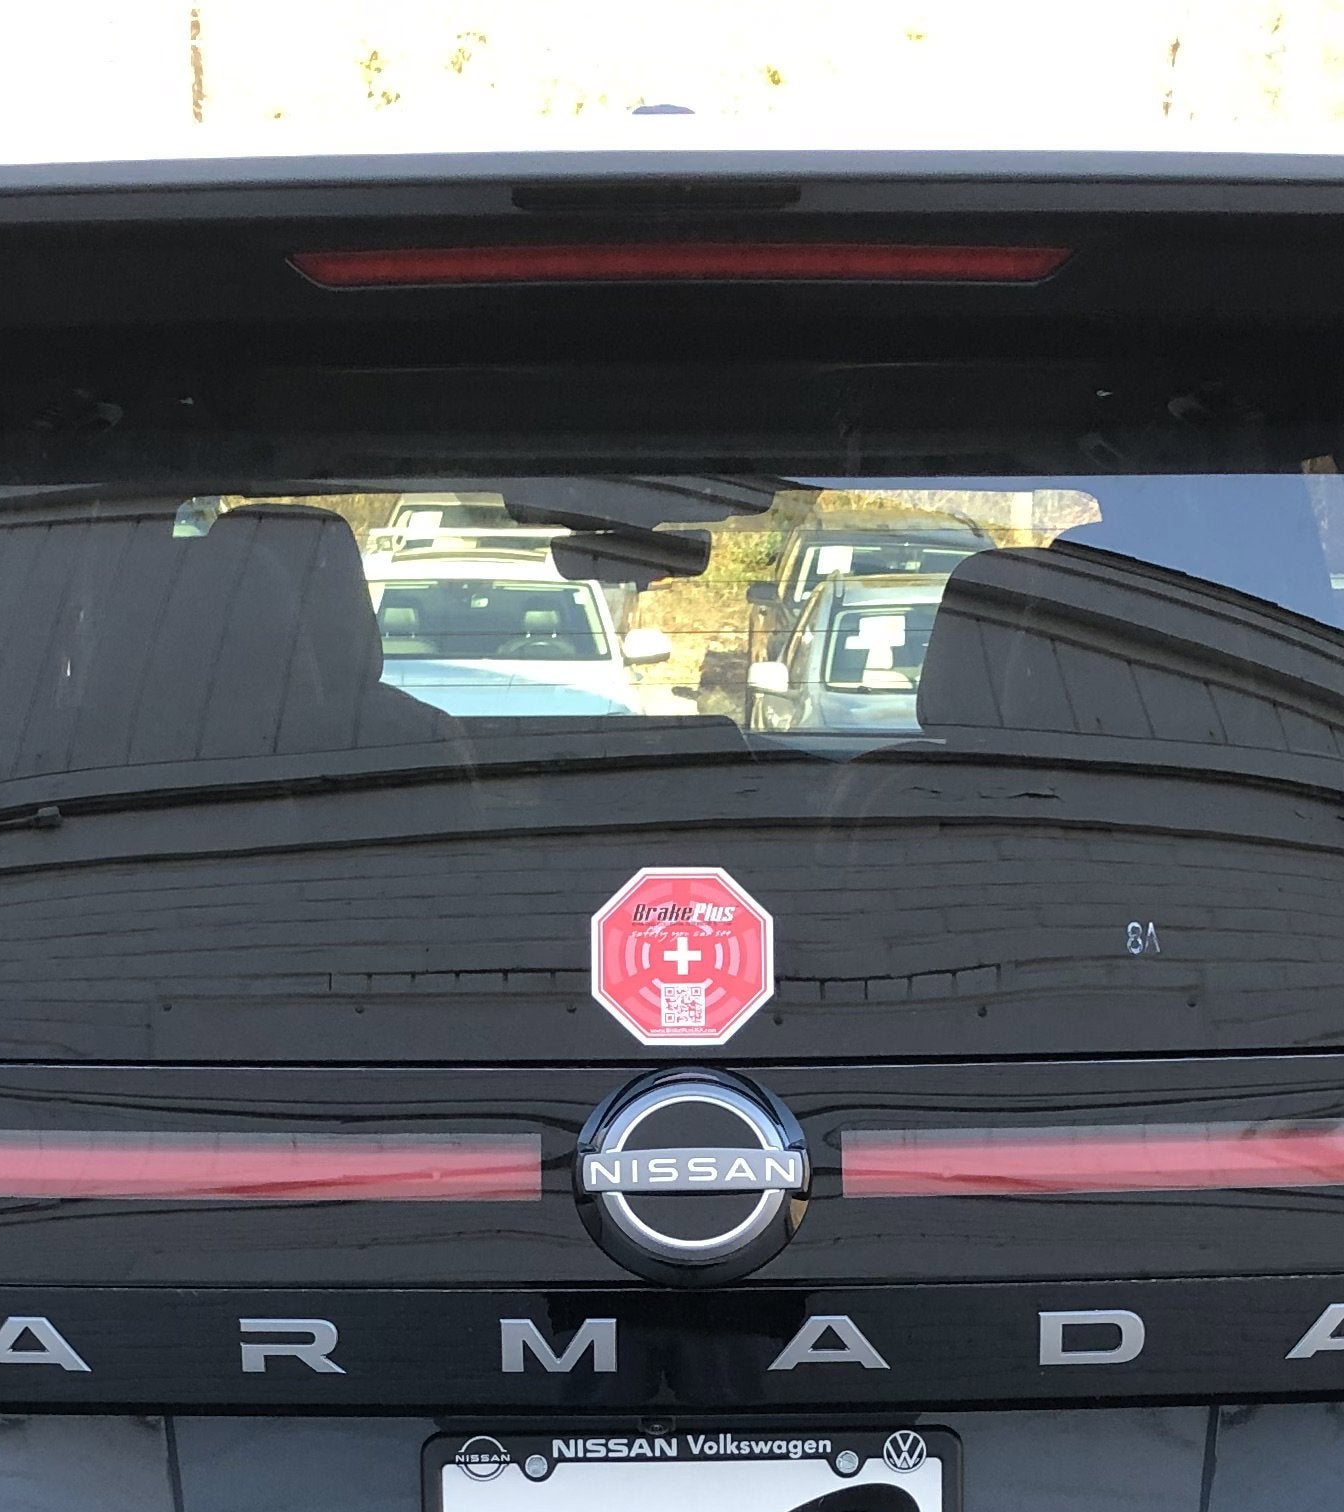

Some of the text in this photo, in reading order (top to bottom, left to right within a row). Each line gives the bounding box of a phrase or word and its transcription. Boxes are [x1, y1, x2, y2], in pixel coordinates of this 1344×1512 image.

[633, 902, 735, 922] BrakePlus
[590, 1156, 795, 1185] NISSAN
[552, 1433, 832, 1459] NISSAN Volkswagen
[455, 1453, 511, 1463] NISSAN
